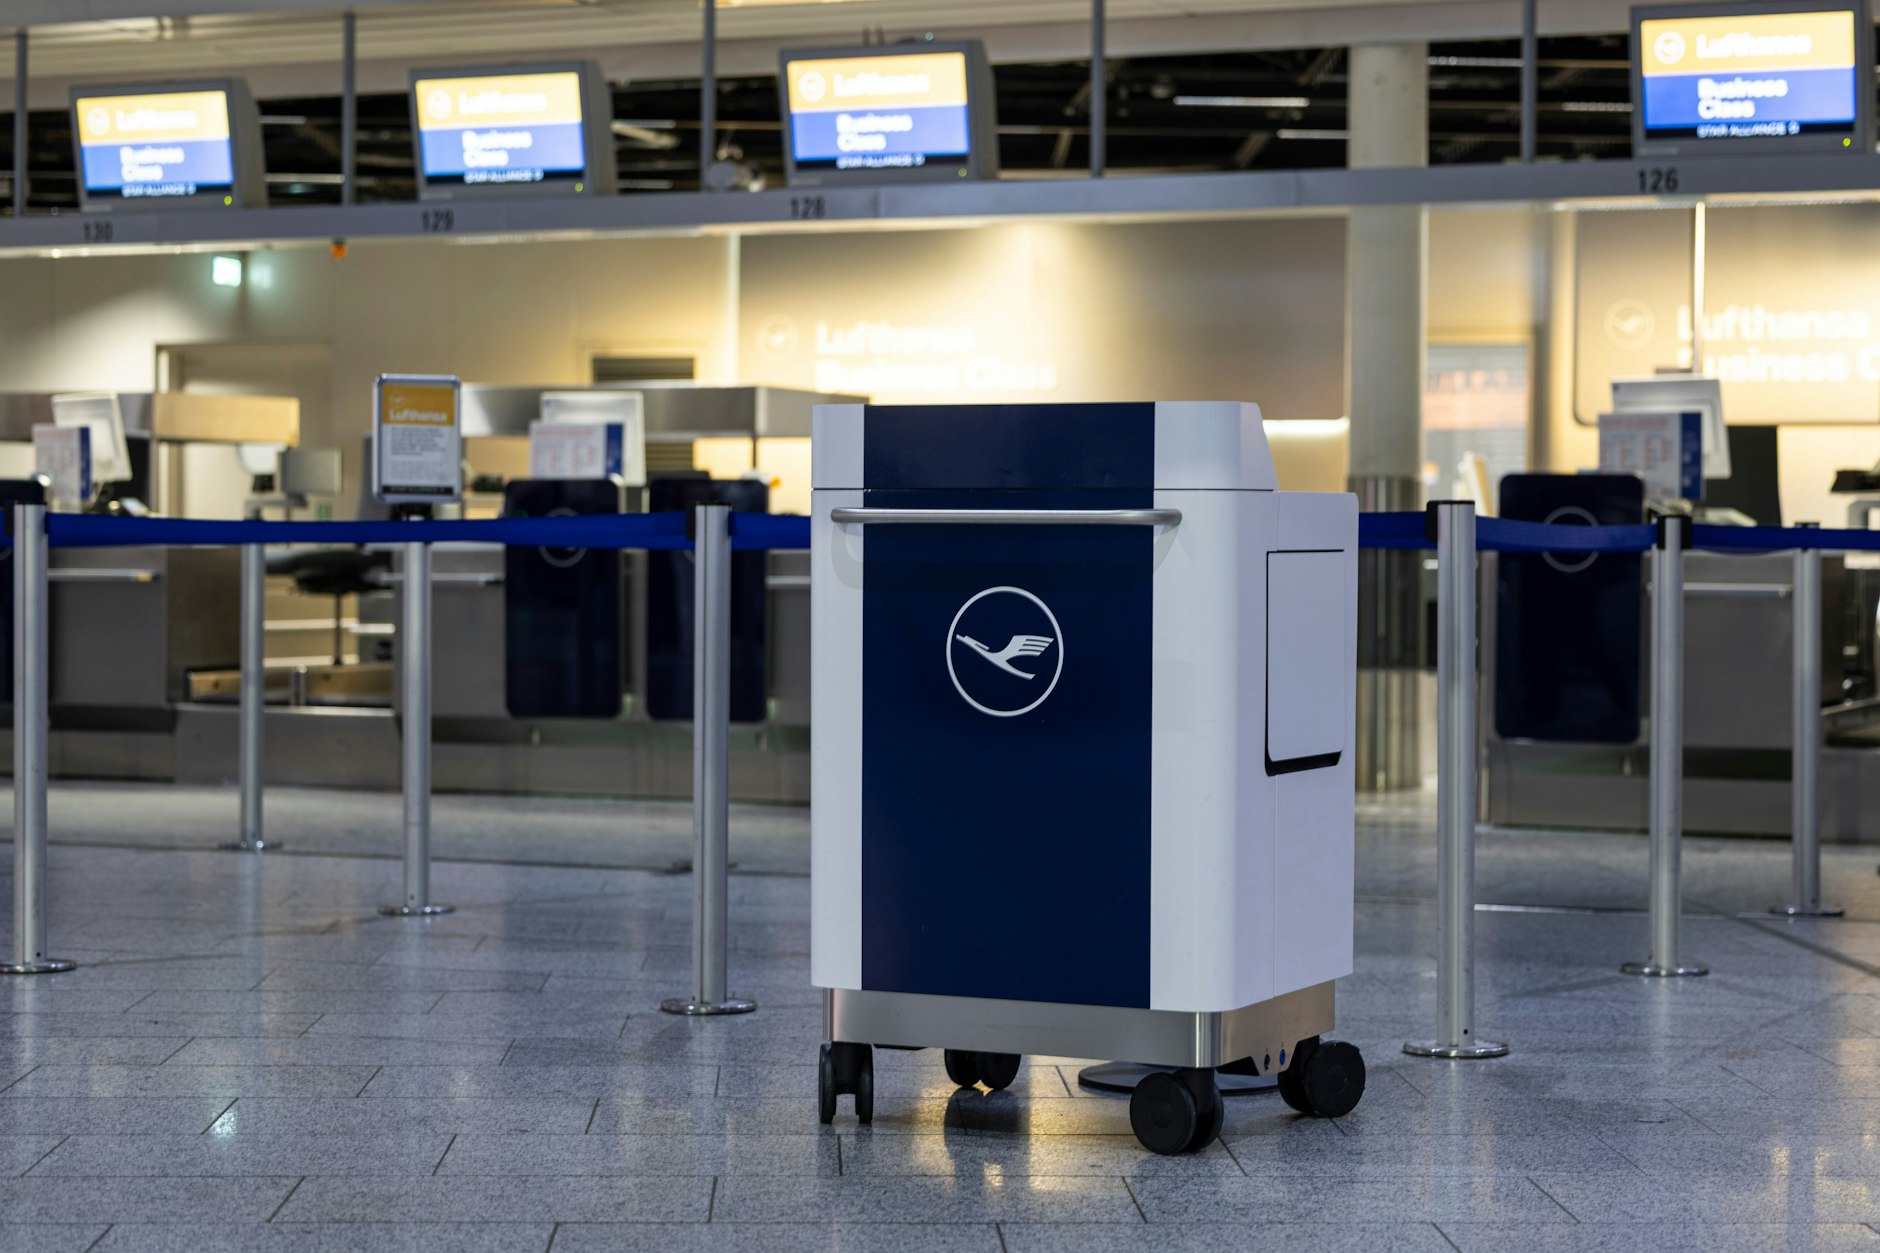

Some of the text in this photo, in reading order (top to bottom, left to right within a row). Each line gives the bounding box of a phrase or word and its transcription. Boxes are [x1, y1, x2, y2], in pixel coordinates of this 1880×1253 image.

[1638, 168, 1679, 193] 126
[791, 196, 826, 218] 128
[422, 209, 454, 231] 129
[389, 408, 448, 422] Lufthansa
